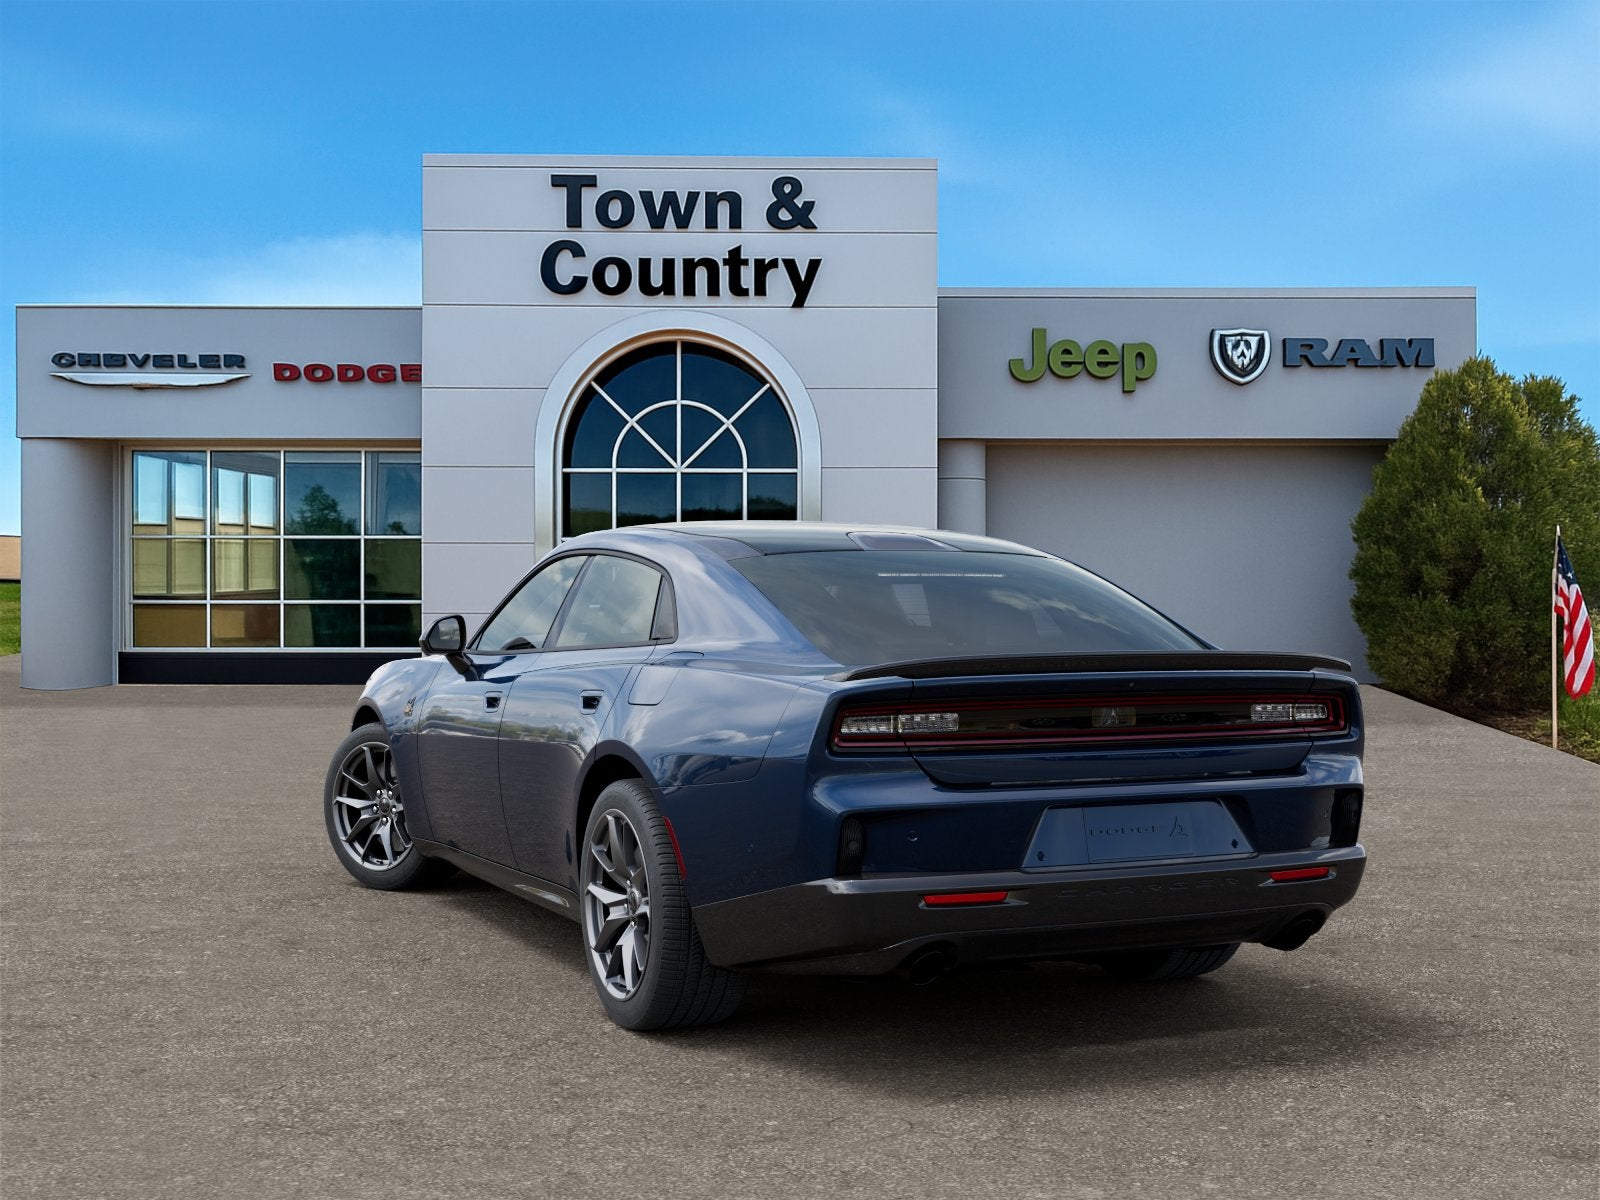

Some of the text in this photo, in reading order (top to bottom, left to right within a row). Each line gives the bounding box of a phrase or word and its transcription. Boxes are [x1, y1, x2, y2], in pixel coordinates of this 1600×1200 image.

[550, 173, 818, 231] Town &
[539, 239, 823, 309] Country
[272, 362, 422, 383] DODGE
[1008, 327, 1158, 394] Jeep
[1282, 337, 1436, 368] RAM
